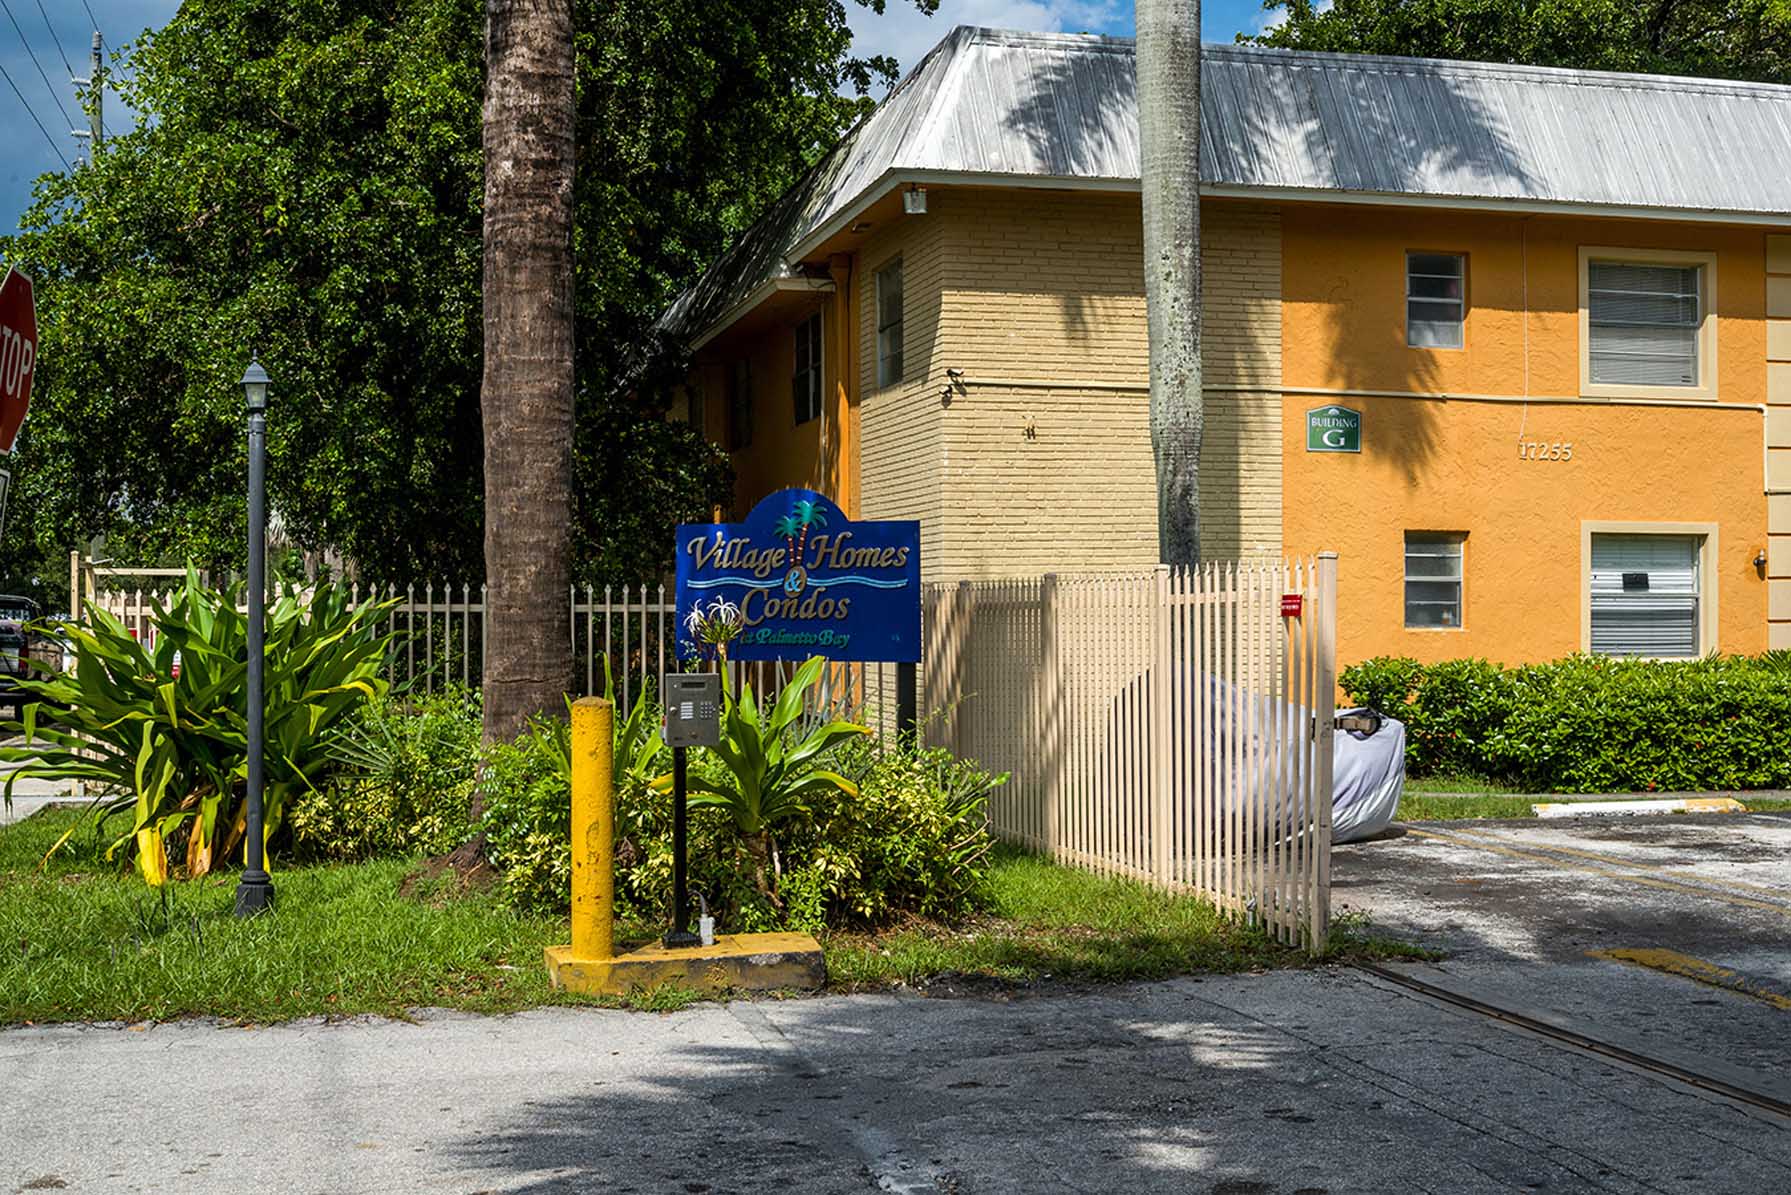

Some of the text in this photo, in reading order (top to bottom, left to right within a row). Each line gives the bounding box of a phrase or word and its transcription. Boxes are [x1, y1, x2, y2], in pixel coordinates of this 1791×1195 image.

[0, 323, 33, 399] TOP
[1311, 417, 1357, 428] BUILDING
[1322, 429, 1345, 448] G
[1519, 441, 1573, 461] 17255
[687, 531, 910, 578] Village Homes
[784, 570, 801, 592] &
[741, 587, 850, 626] Condos
[756, 628, 818, 645] Palmetto
[819, 629, 850, 649] Bay
